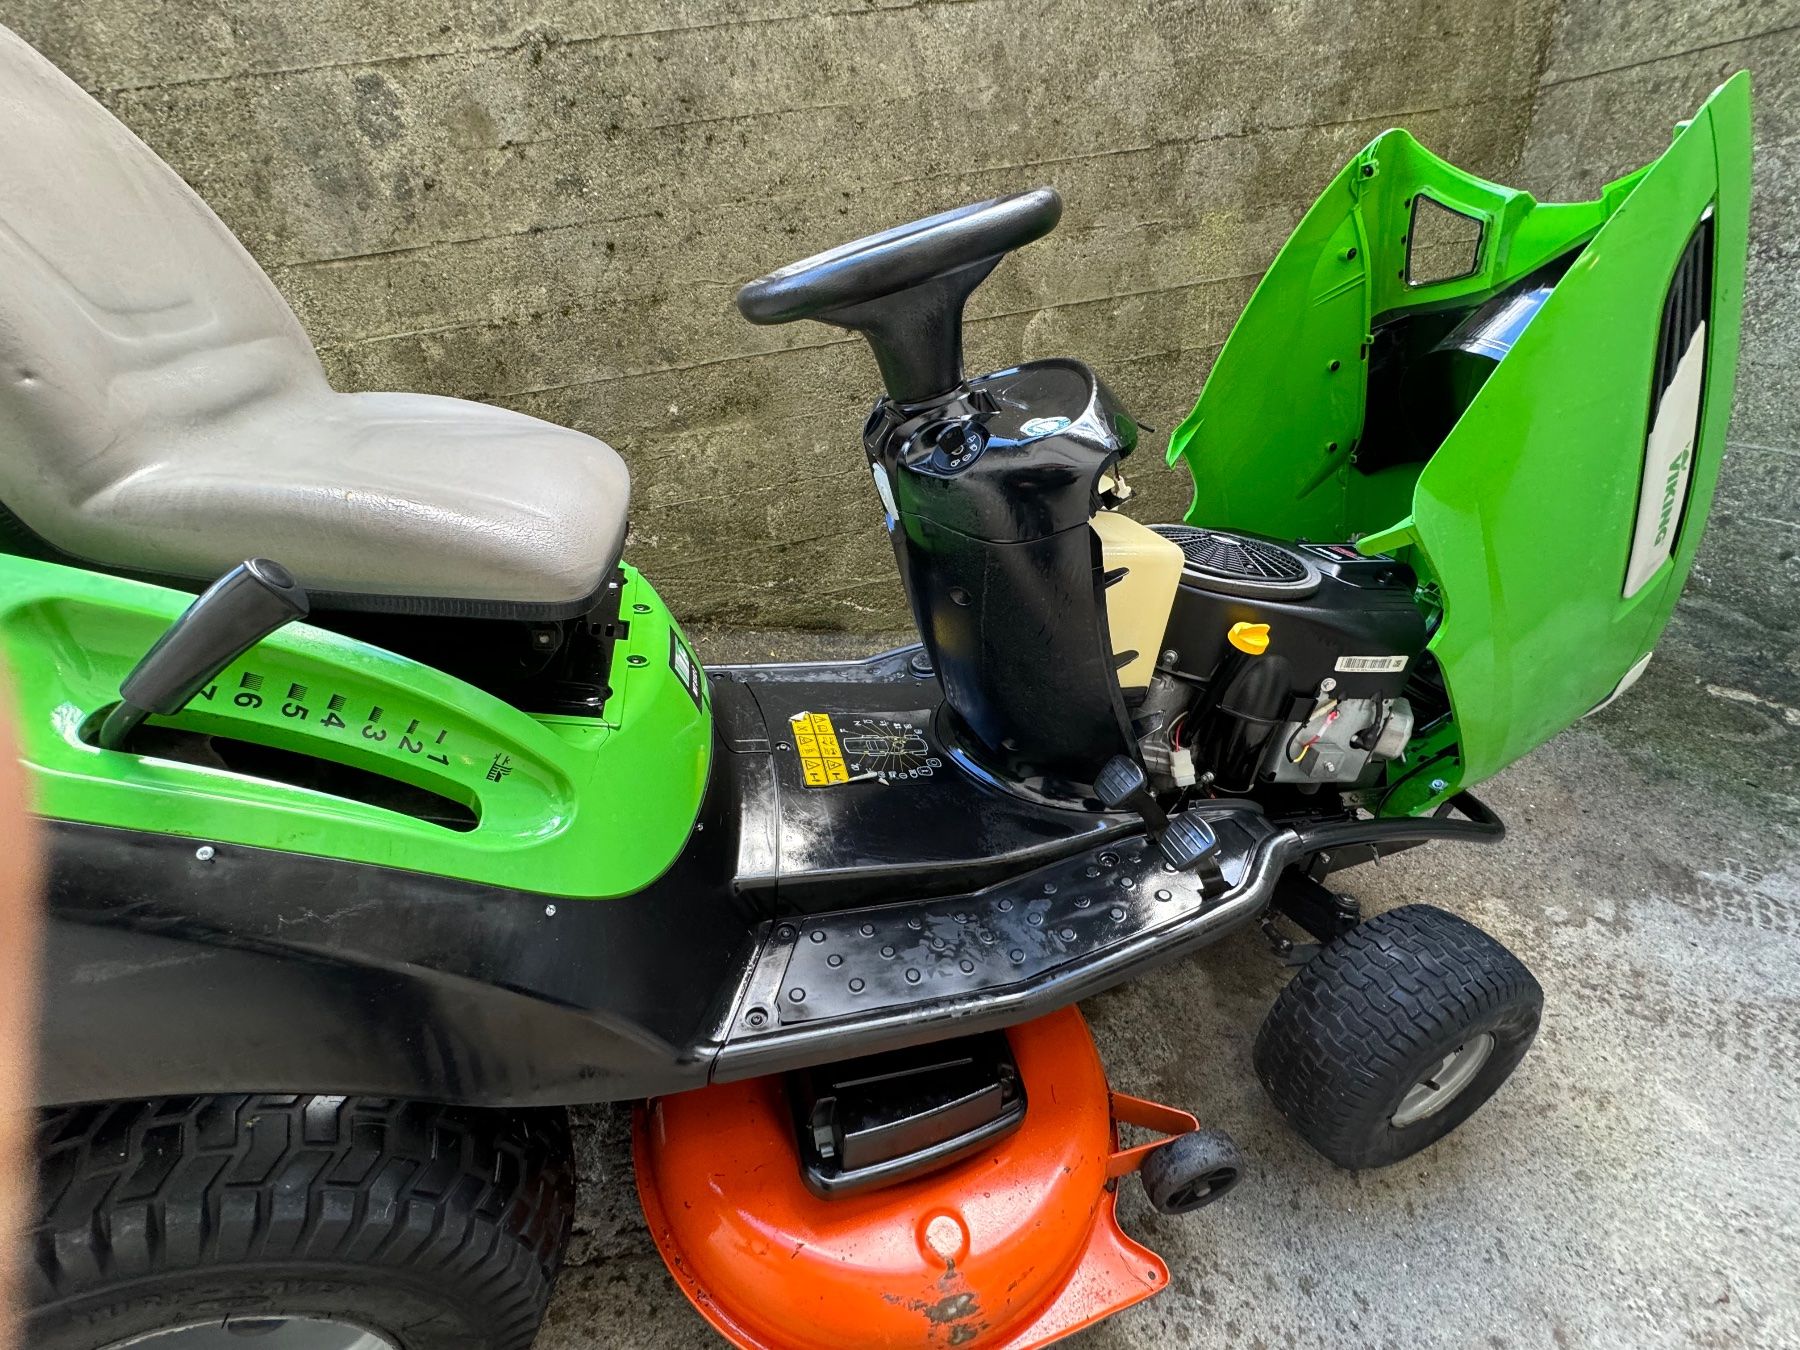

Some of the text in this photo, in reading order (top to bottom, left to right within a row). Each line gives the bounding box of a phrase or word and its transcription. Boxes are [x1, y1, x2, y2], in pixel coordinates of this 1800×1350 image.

[1654, 449, 1688, 546] VIKING
[233, 692, 263, 709] 6
[281, 702, 309, 721] 5
[320, 711, 346, 729] 4
[361, 724, 387, 742] 3
[398, 735, 424, 754] 2
[426, 753, 450, 766] 1
